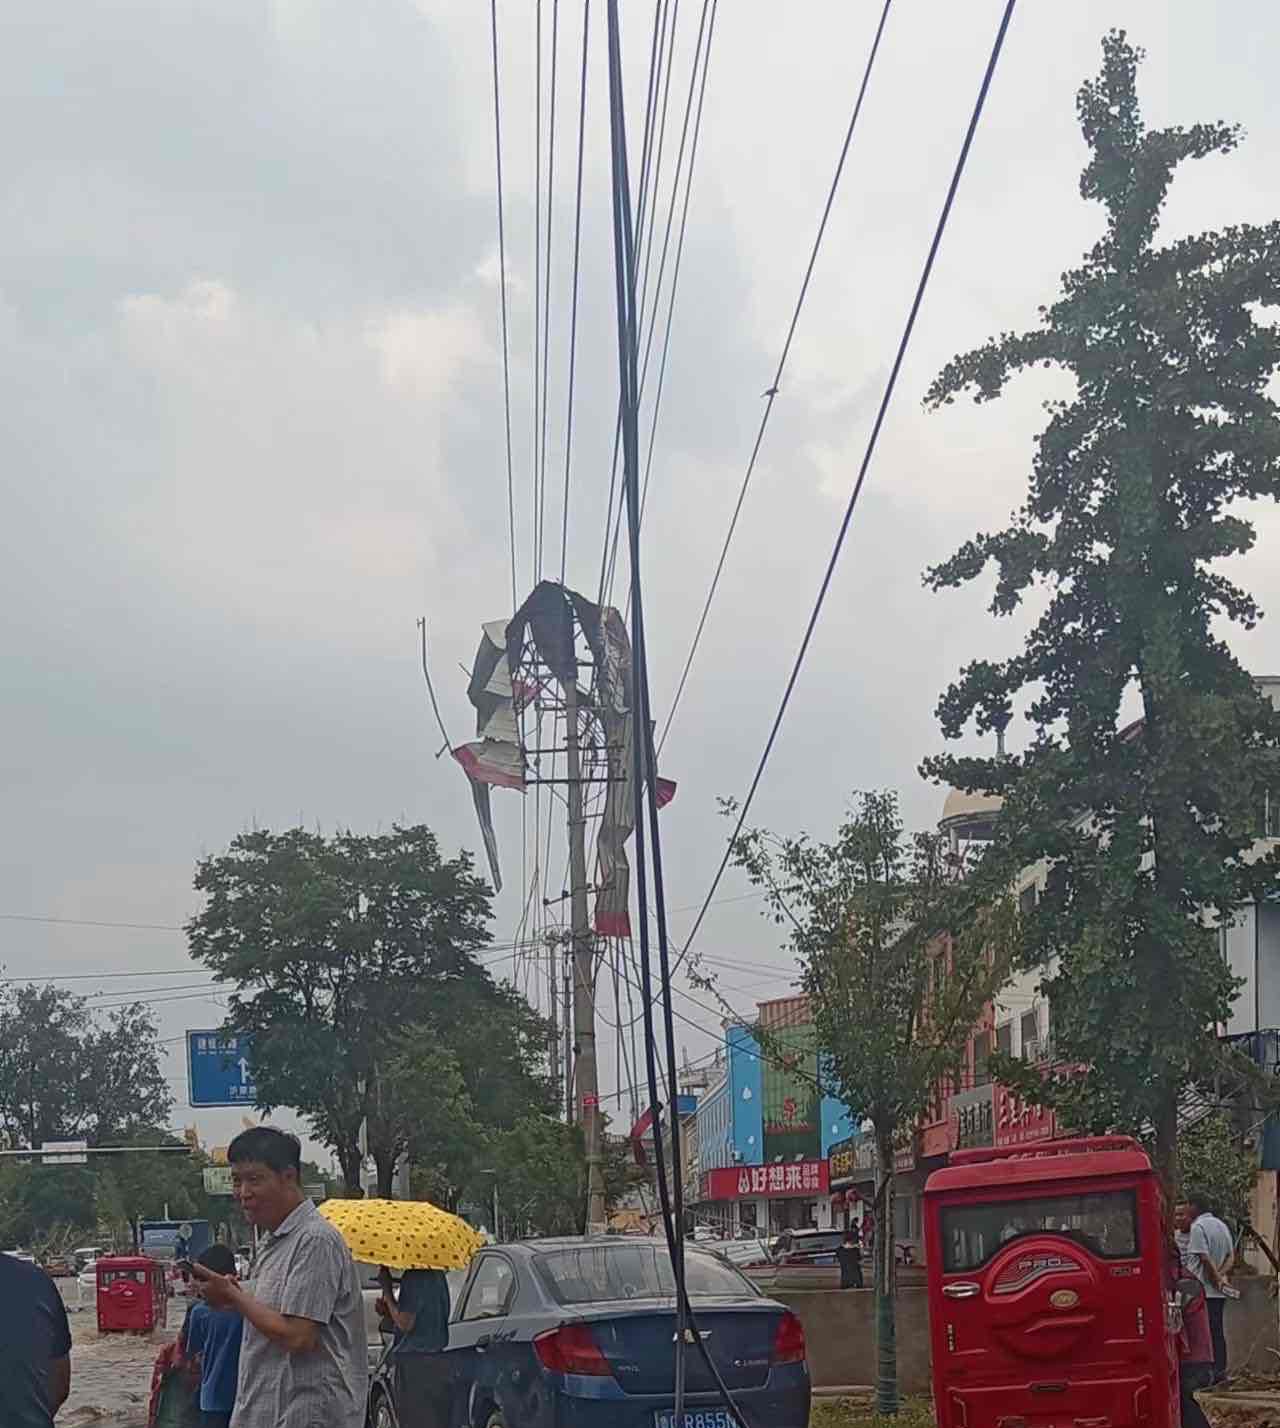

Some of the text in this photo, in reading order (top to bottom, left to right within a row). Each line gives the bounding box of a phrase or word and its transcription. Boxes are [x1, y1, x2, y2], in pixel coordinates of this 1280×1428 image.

[751, 1164, 801, 1193] 好想来
[1018, 1256, 1062, 1270] PRO
